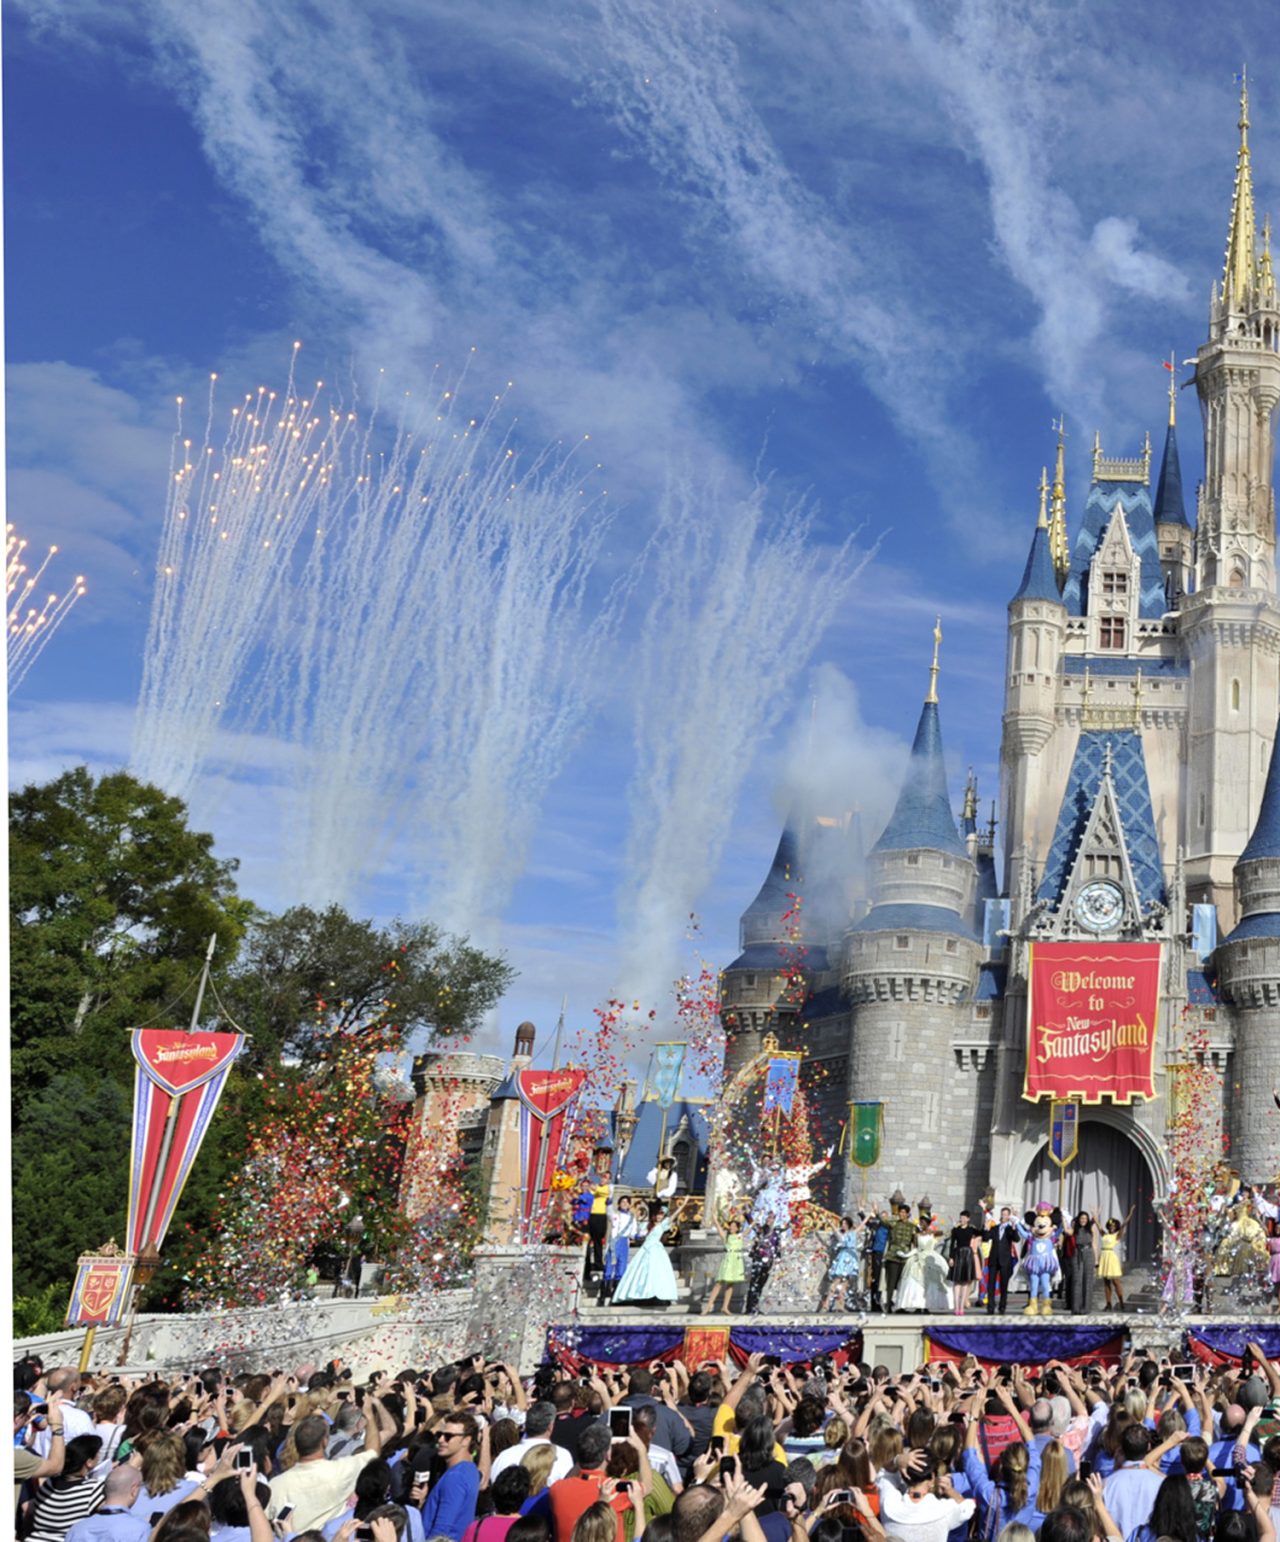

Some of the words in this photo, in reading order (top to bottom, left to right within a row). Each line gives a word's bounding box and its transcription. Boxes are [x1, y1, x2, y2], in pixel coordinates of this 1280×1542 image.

[1051, 970, 1136, 993] Welcome
[1087, 994, 1105, 1011] to
[1065, 1016, 1092, 1032] New
[1036, 1012, 1149, 1064] Fantasyland
